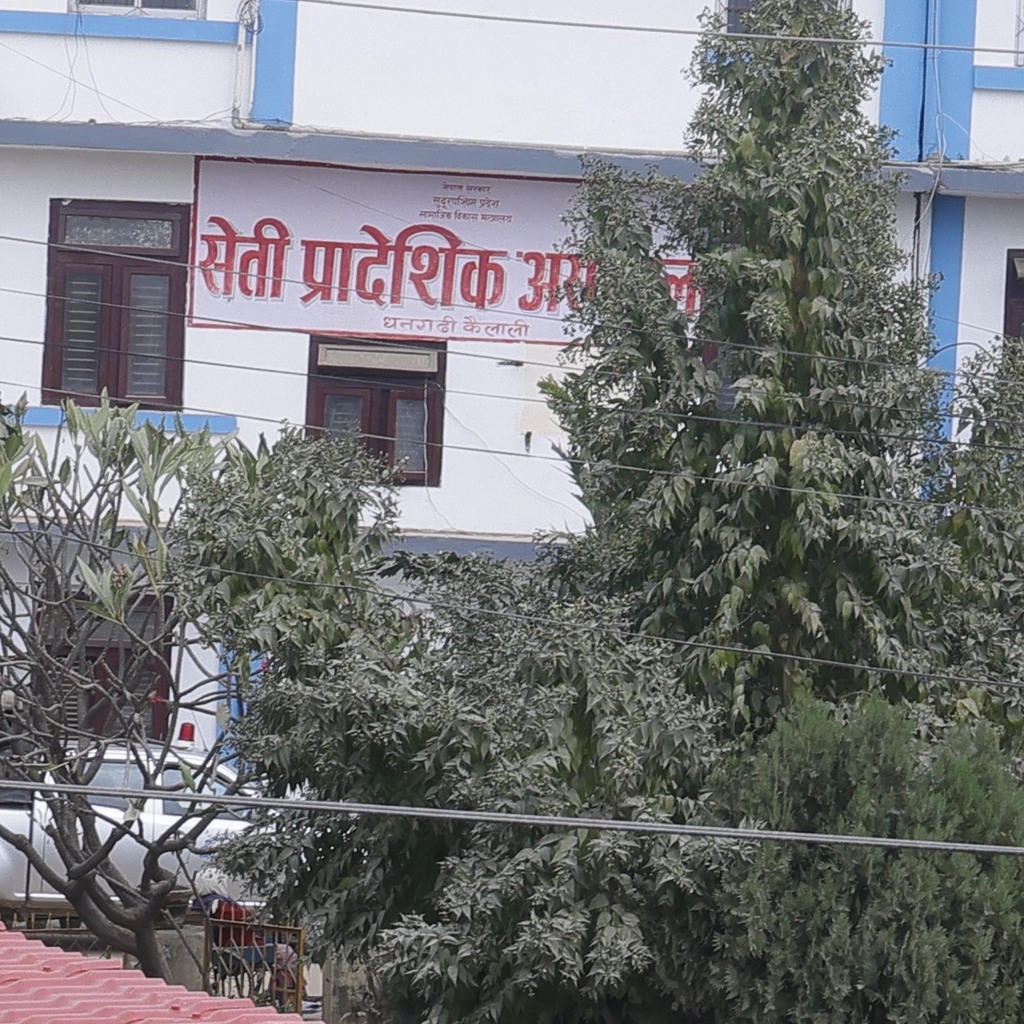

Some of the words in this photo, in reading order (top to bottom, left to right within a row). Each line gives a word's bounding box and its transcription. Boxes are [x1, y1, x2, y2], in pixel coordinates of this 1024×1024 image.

[199, 216, 292, 298] सेती
[300, 224, 508, 310] प्रादेशिक
[462, 315, 530, 337] कैलाली
